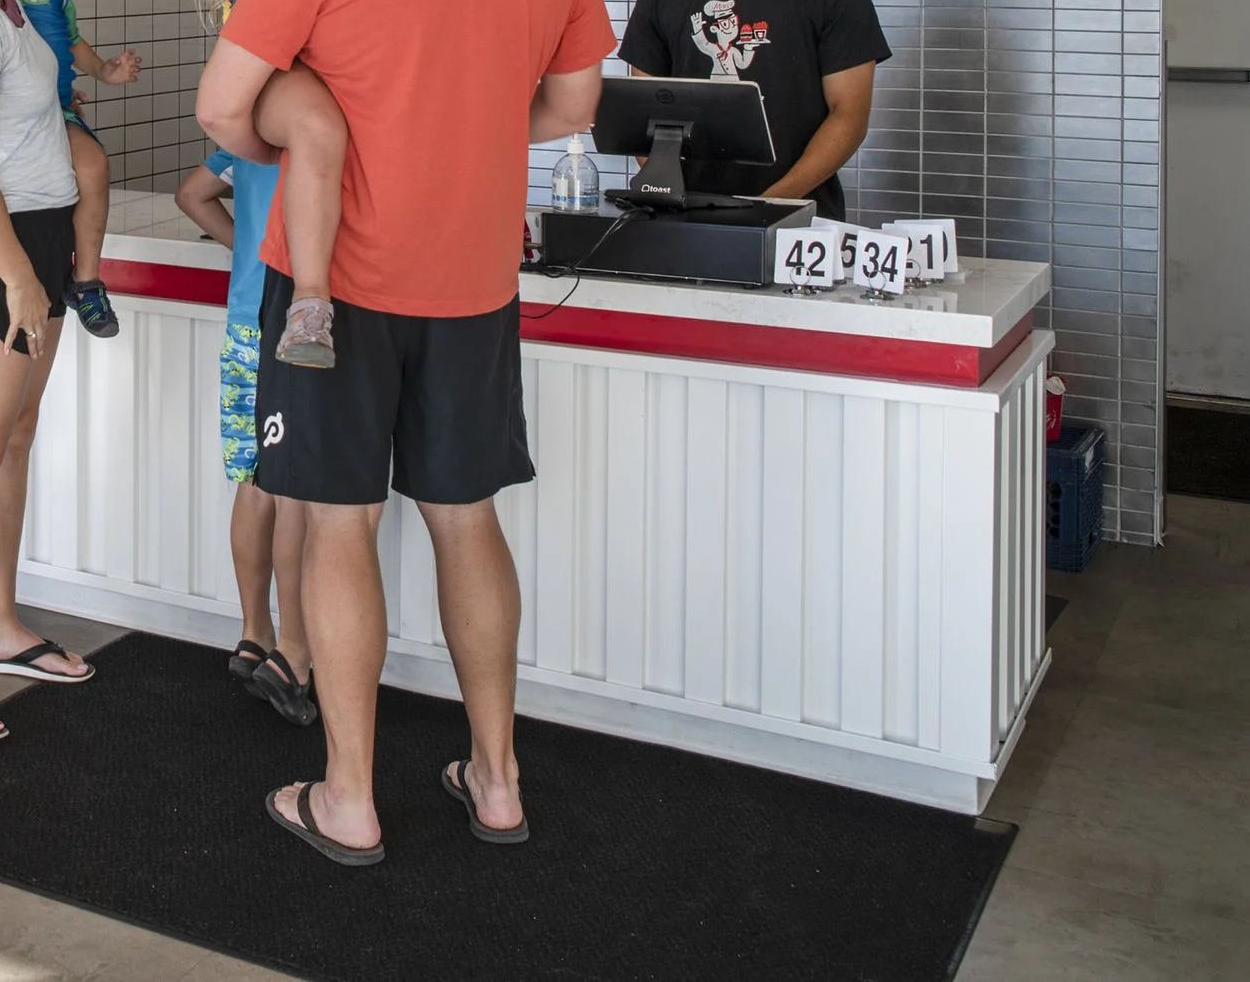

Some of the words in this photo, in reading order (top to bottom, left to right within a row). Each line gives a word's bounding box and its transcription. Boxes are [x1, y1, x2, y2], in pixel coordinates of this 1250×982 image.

[650, 185, 671, 193] toast
[785, 240, 826, 277] 42
[862, 242, 898, 282] 34
